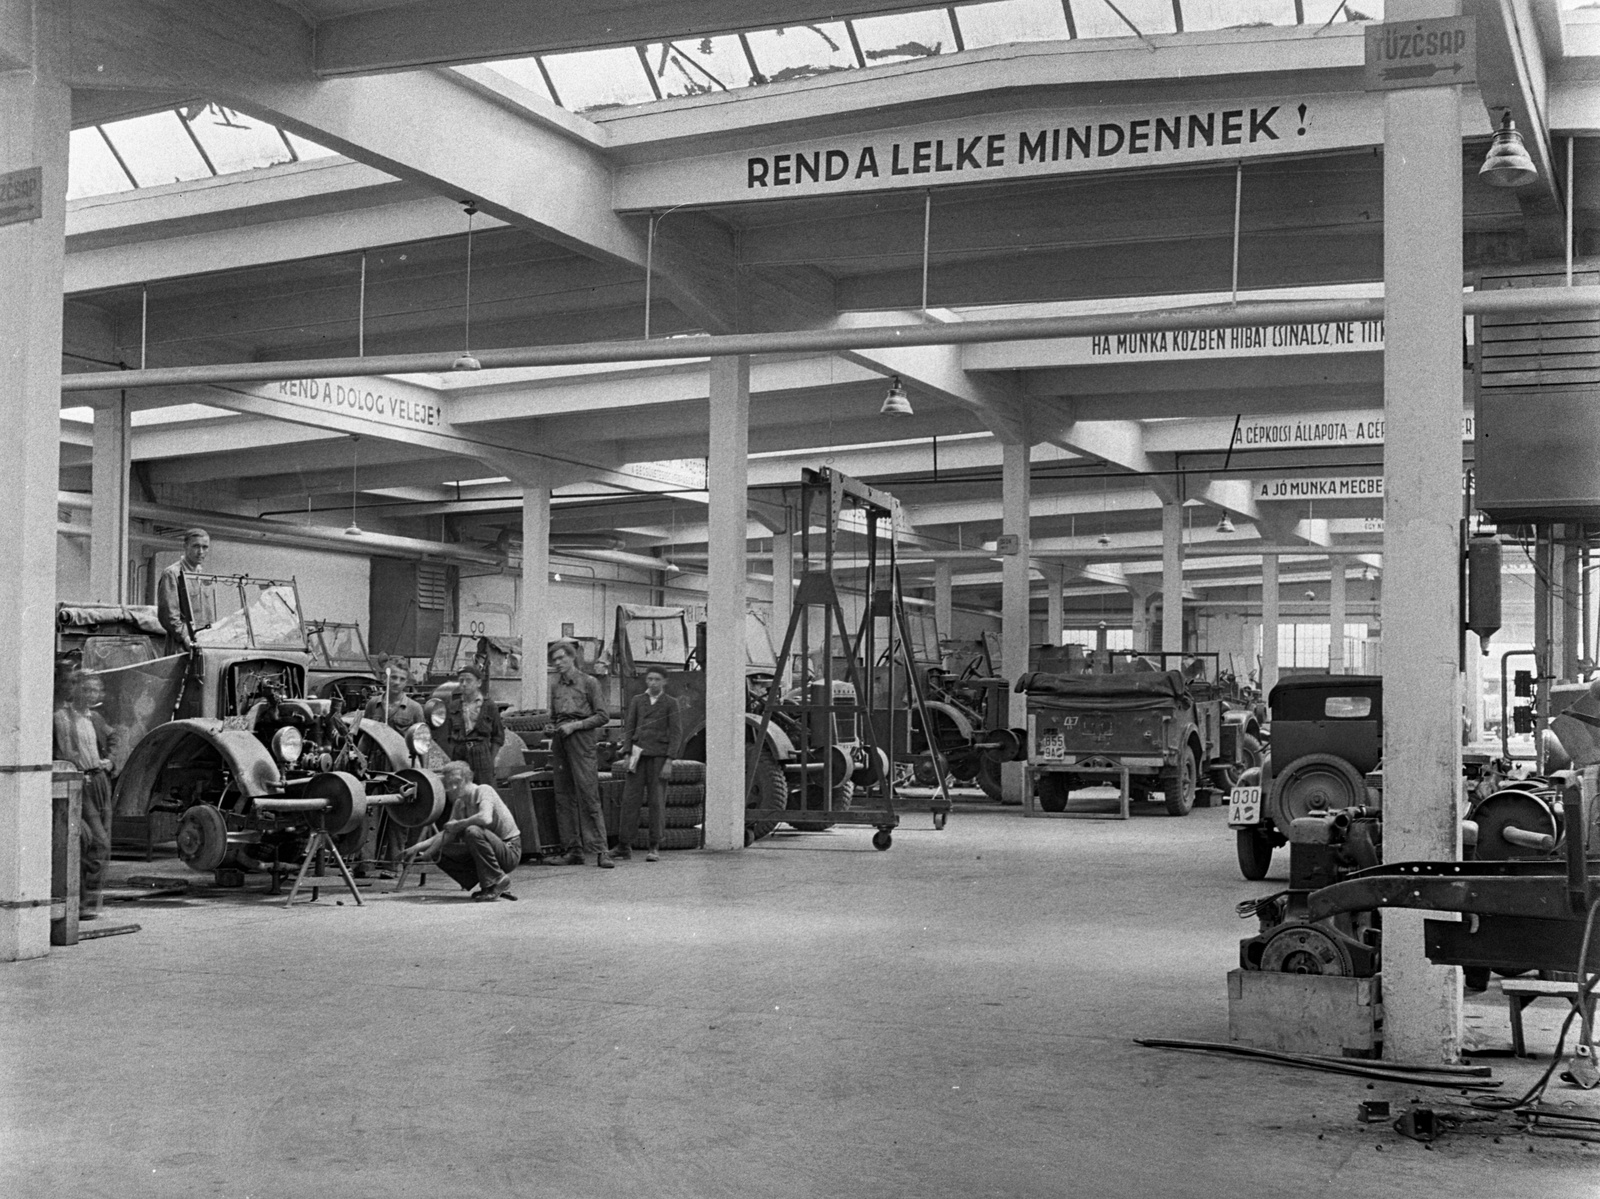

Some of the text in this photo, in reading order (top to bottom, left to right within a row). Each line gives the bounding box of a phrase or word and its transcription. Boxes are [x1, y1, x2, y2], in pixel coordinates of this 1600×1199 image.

[748, 149, 850, 188] REND
[855, 146, 879, 179] A
[891, 134, 1006, 176] LELKE
[1018, 106, 1281, 165] MINDENNEK
[1092, 336, 1111, 355] HA
[1117, 332, 1168, 355] MUNKA
[1335, 322, 1354, 344] NE
[279, 379, 319, 400] REND
[322, 382, 332, 404] A
[336, 384, 385, 414] DOLOG
[1235, 427, 1243, 444] A
[1356, 422, 1365, 439] A
[1260, 484, 1269, 496] A
[1272, 479, 1287, 496] JÓ
[1290, 480, 1337, 495] MUNKA
[1232, 789, 1259, 805] 030
[1233, 806, 1241, 821] A
